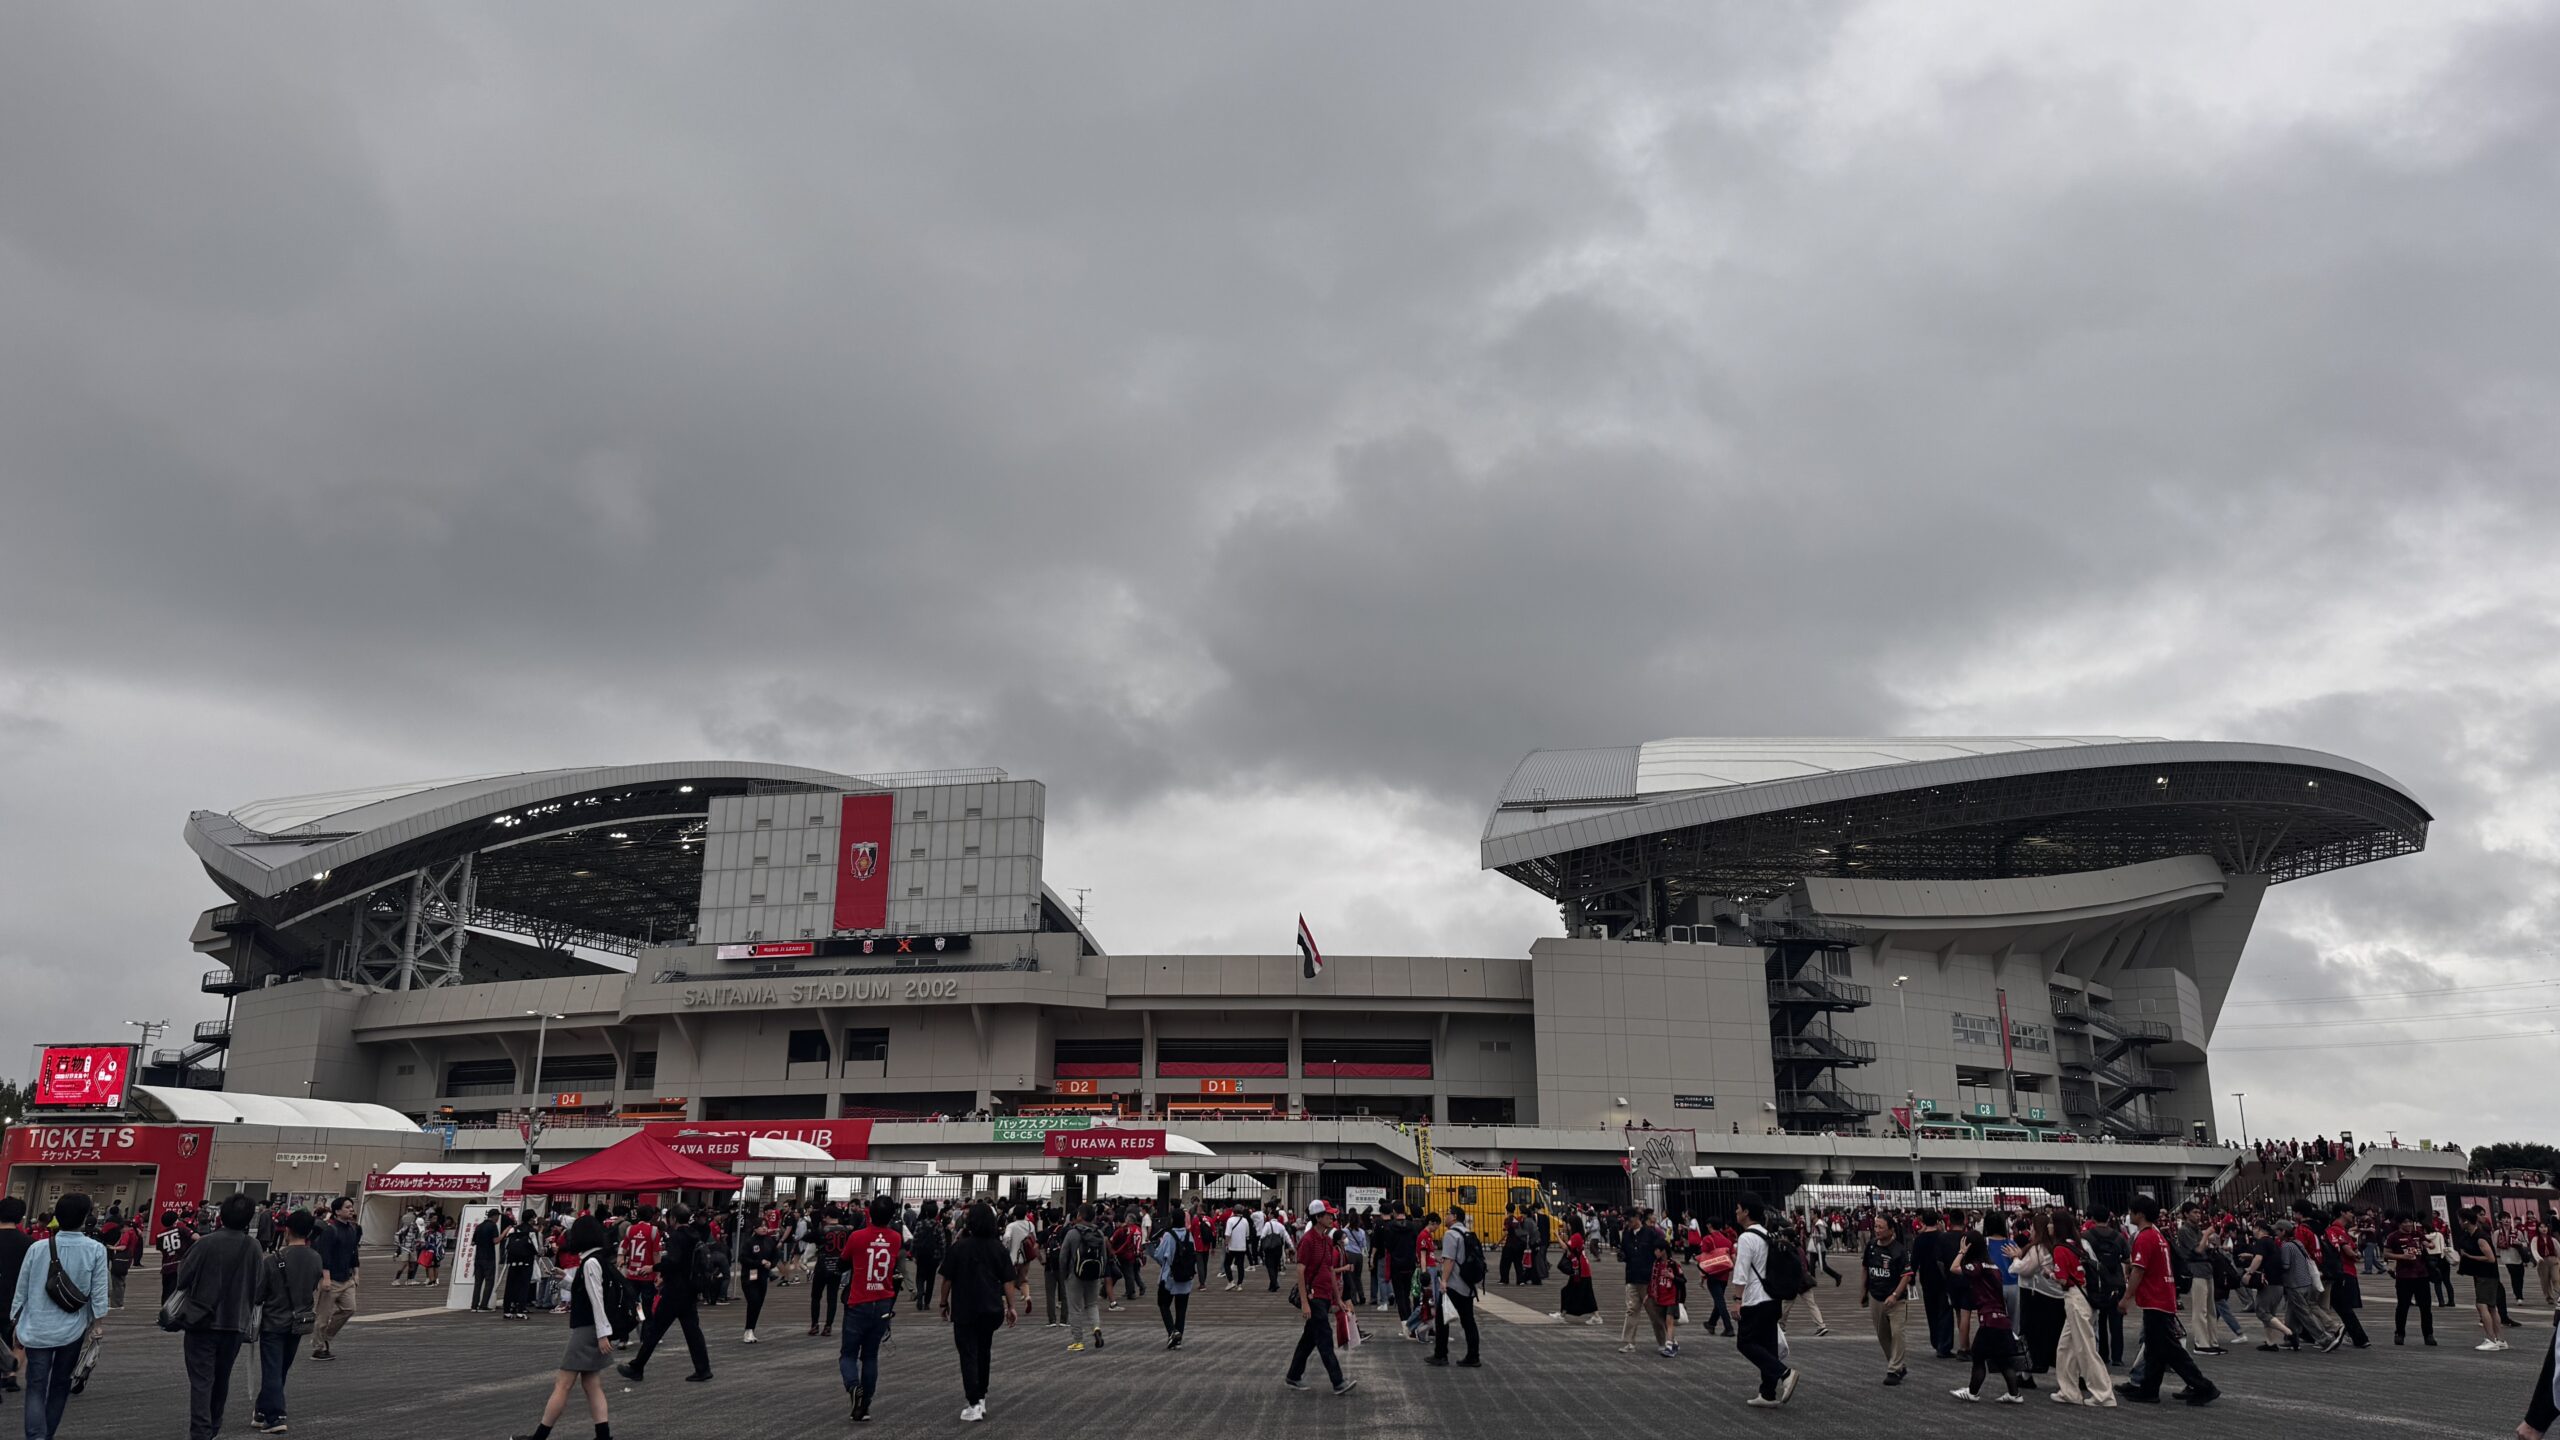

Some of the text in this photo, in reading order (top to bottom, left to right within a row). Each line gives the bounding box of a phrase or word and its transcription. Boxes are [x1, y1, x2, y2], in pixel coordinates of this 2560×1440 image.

[682, 979, 958, 1006] SAITAMA STADIUM 2002
[57, 1056, 85, 1072] 荷物
[1070, 1081, 1089, 1092] D2
[1208, 1080, 1227, 1092] D1
[562, 1094, 576, 1105] D4
[1920, 1100, 1932, 1111] C9
[1980, 1105, 1991, 1115] C8
[2031, 1109, 2040, 1118] C7
[998, 1119, 1069, 1129] バックスタンド
[29, 1127, 135, 1149] TICKETS
[1071, 1137, 1155, 1149] URAWA REDS
[667, 1144, 740, 1154] RAWA REDS
[41, 1150, 101, 1160] チケットブース
[162, 1232, 182, 1253] 46
[630, 1239, 647, 1261] 14
[866, 1247, 891, 1282] 13
